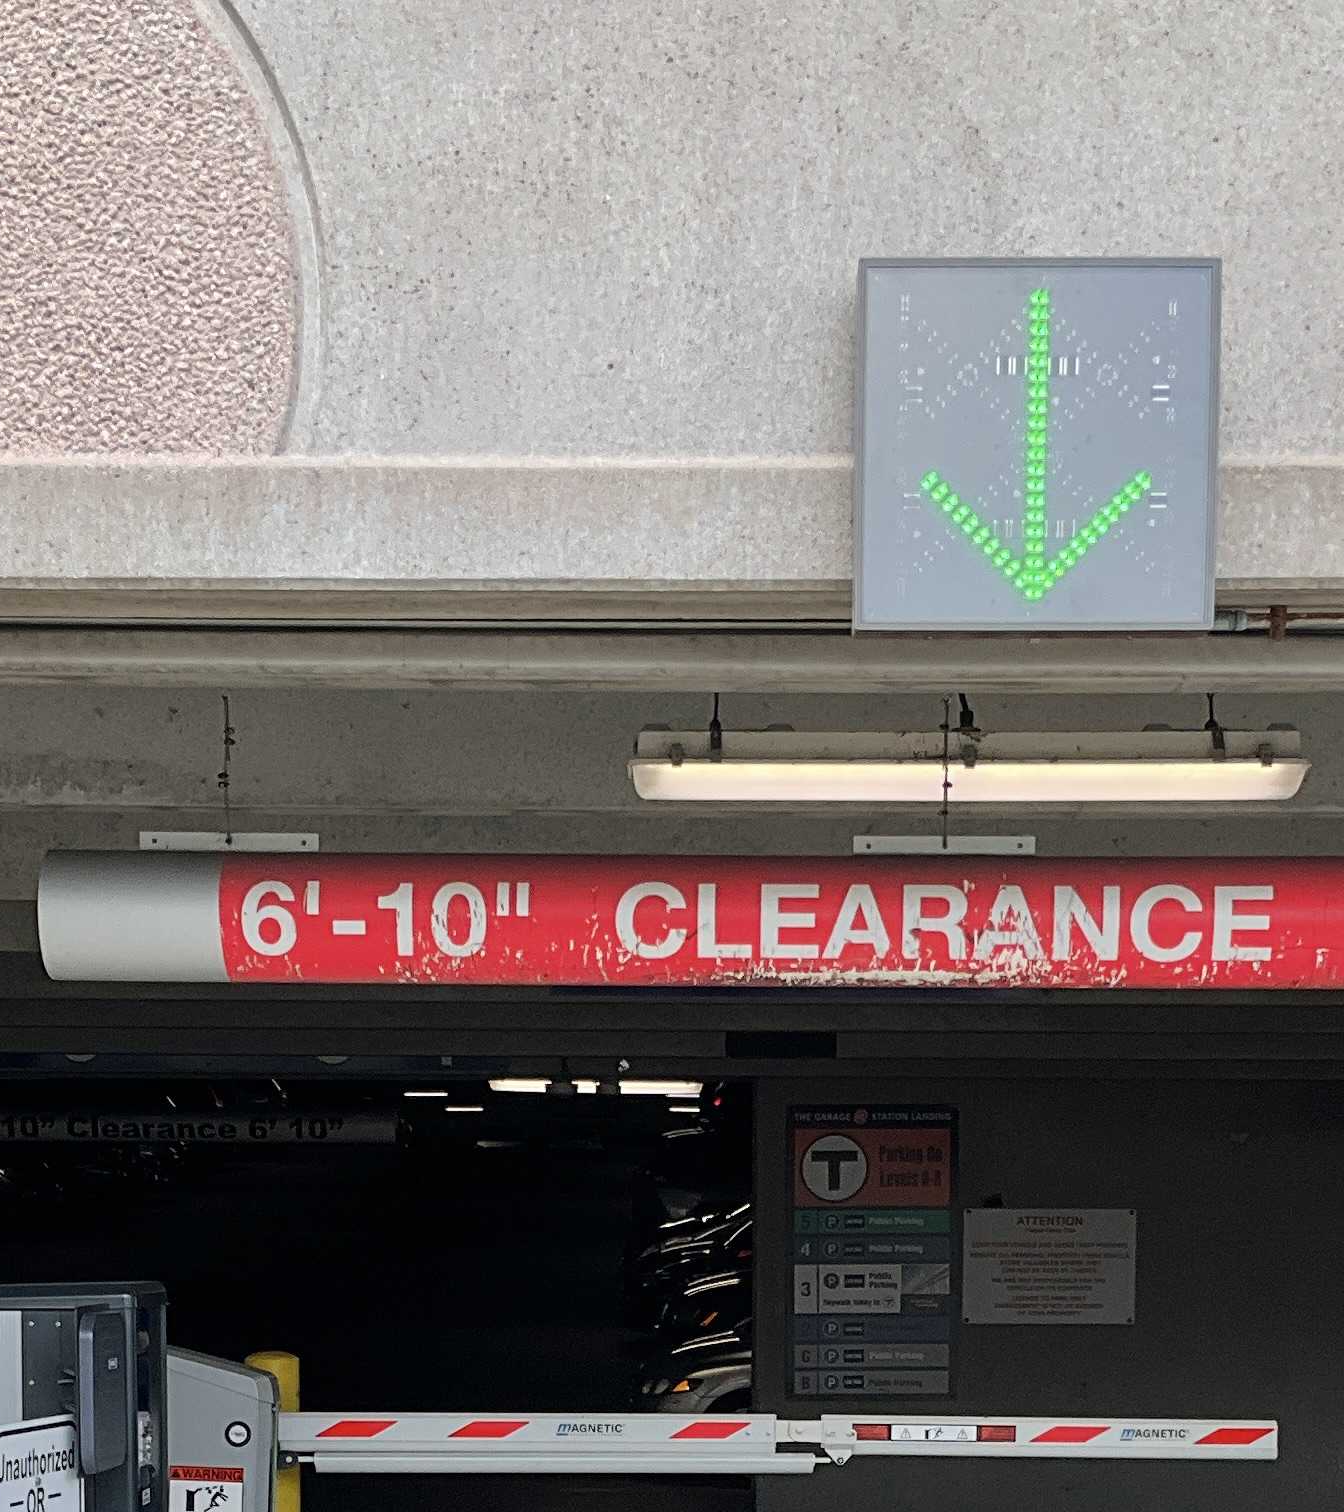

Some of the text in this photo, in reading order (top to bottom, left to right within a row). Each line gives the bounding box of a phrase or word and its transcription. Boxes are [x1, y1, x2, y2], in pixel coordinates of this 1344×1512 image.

[240, 881, 530, 958] 6'-10"
[616, 883, 1273, 964] CLEARANCE
[66, 1118, 237, 1138] Clearance
[811, 1150, 859, 1191] T
[1016, 1216, 1083, 1226] ATTENTION
[182, 1469, 242, 1481] WARNING
